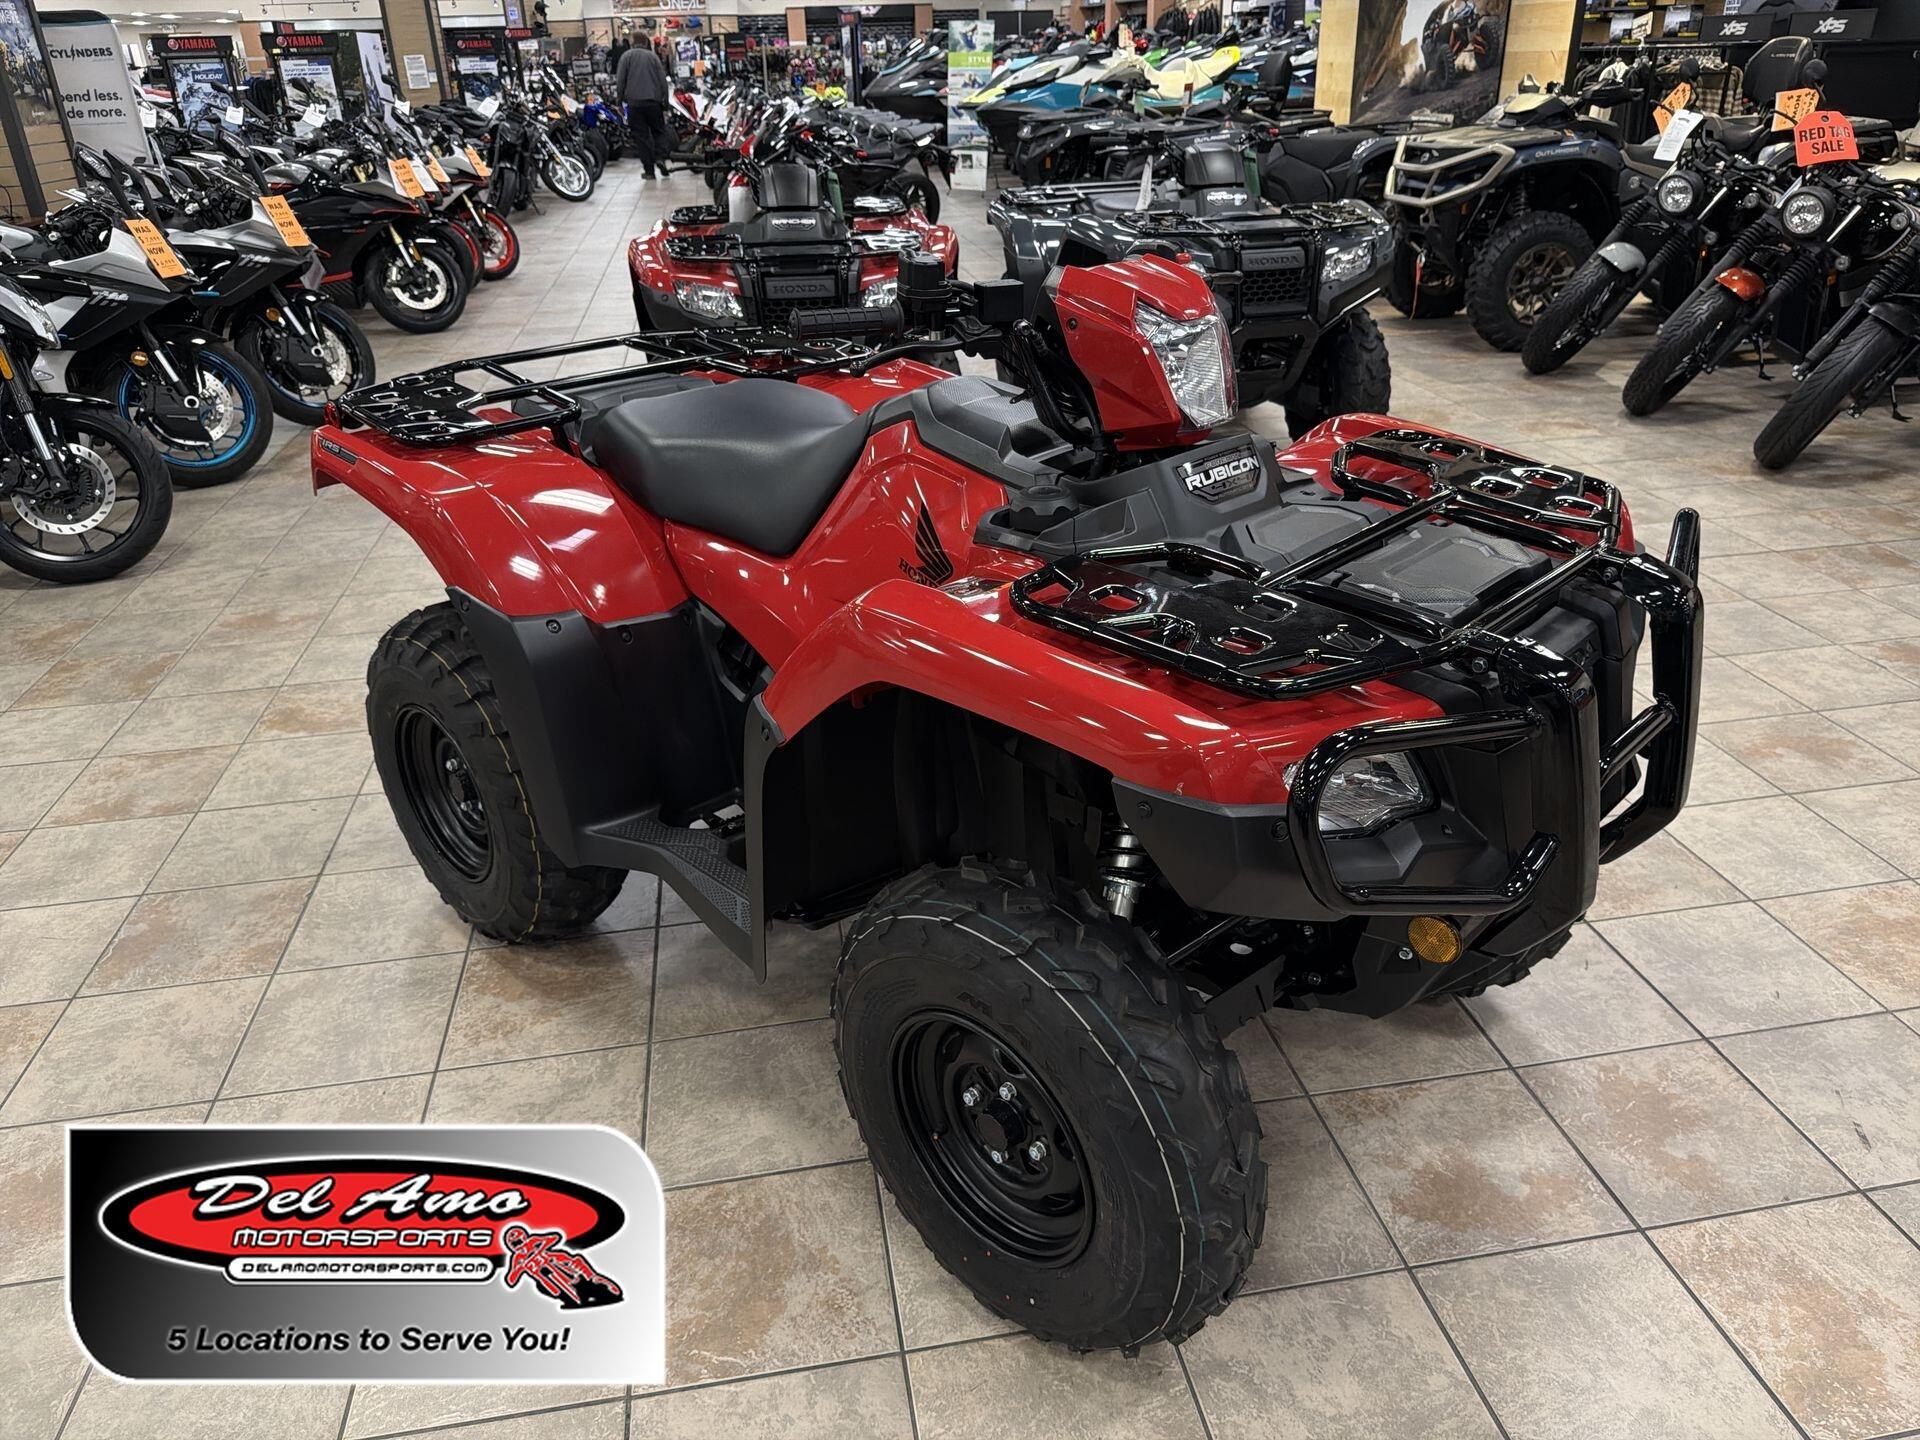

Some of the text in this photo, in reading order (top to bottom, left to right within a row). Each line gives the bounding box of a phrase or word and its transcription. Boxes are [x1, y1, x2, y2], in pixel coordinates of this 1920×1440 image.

[1719, 20, 1749, 36] XPS
[1814, 17, 1848, 33] XPS
[179, 39, 216, 49] YAMAHA
[286, 36, 324, 46] YAMAHA
[465, 40, 493, 48] YAMAHA
[94, 89, 123, 101] less.
[88, 108, 127, 118] more.
[1799, 126, 1851, 142] RED TAG
[1811, 140, 1845, 155] SALE
[267, 202, 284, 210] WAS
[134, 226, 152, 234] WAS
[278, 221, 295, 229] NOW
[147, 246, 165, 255] NOW
[1247, 256, 1300, 267] HONDA
[773, 285, 831, 295] HONDA
[322, 439, 341, 453] IRS
[1185, 456, 1260, 491] RUBICON
